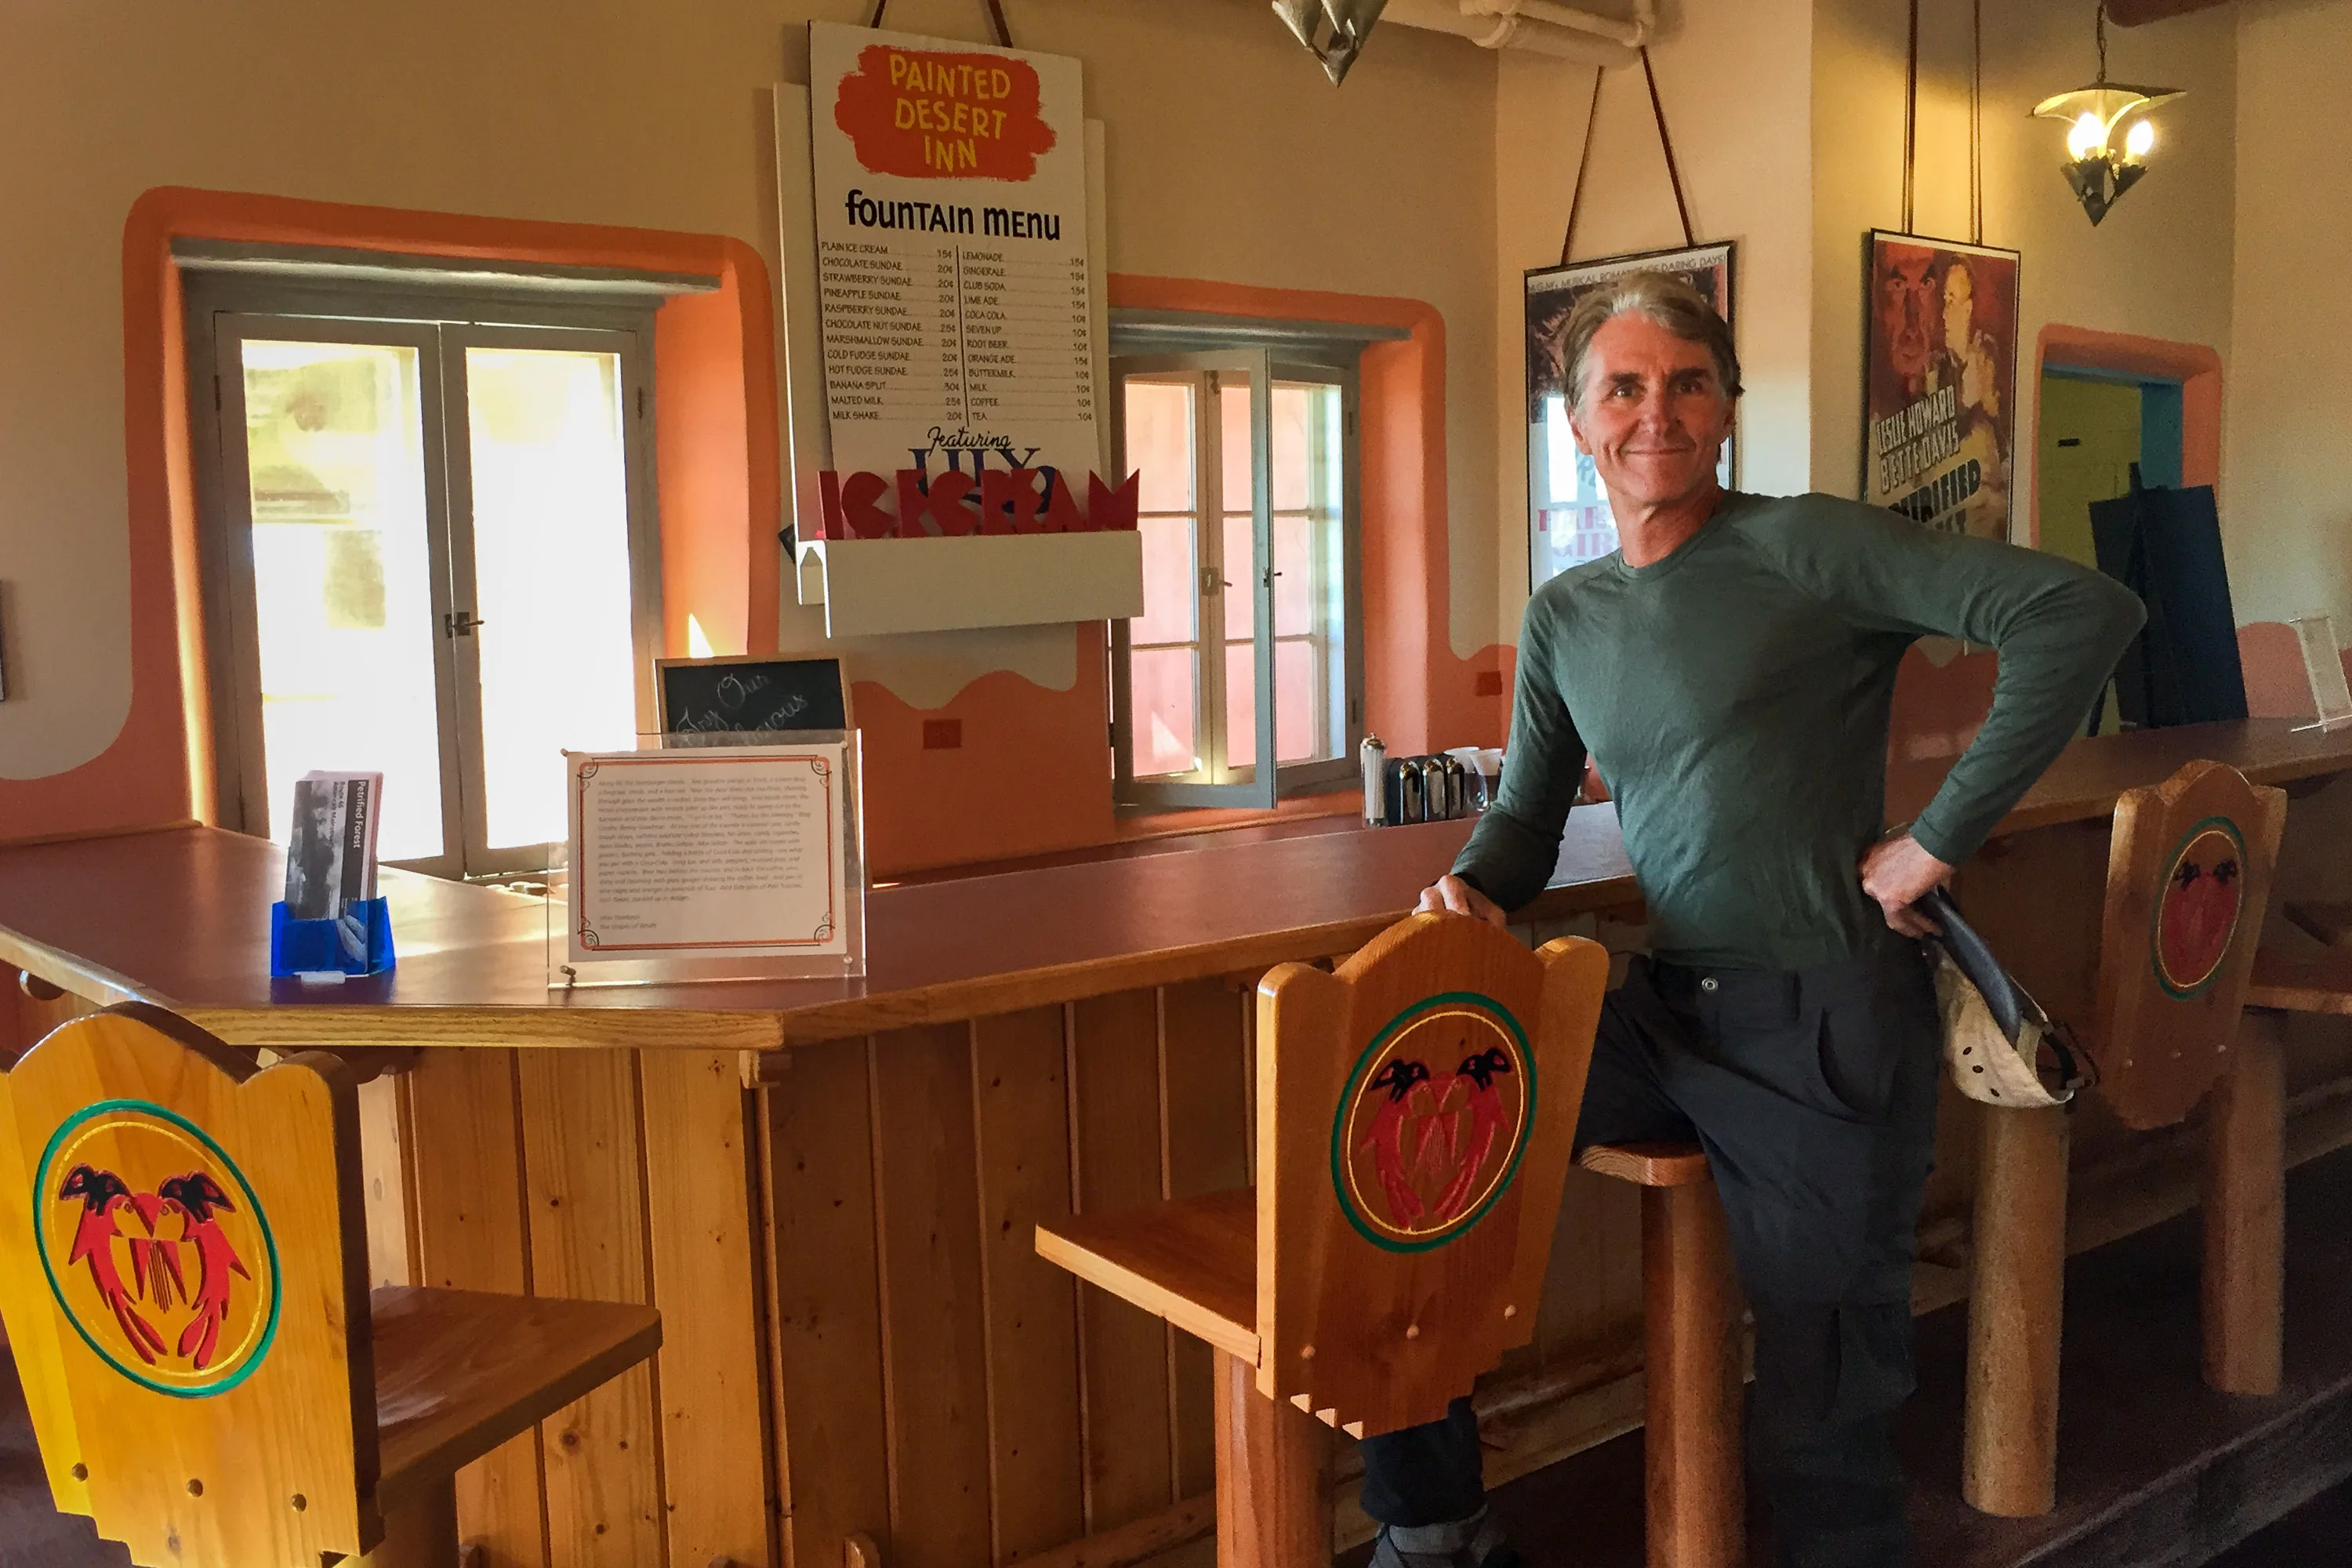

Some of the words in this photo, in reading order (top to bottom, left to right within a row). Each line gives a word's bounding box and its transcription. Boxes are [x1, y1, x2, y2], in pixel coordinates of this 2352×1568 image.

[890, 54, 1011, 100] PAINTED
[895, 97, 1007, 140] DESERT
[924, 135, 977, 172] INN
[822, 241, 844, 252] PLAIN
[845, 244, 858, 252] ICE
[859, 245, 887, 254] CREAM
[962, 252, 1004, 263] LEMONADE
[822, 258, 868, 268] CHOCOLATE
[869, 260, 902, 270] SUNDAE
[937, 265, 953, 274] 20¢
[823, 274, 878, 284] STRAWBERRY
[880, 277, 912, 286] SUNDAE
[938, 279, 954, 289] 20¢
[964, 281, 982, 290] CLUB
[984, 282, 1007, 292] SODA
[824, 288, 867, 299] PINEAPPLE
[869, 290, 901, 301] SUNDAE
[939, 295, 955, 303] 20¢
[964, 296, 982, 305] LIME
[983, 297, 999, 306] ADE
[825, 303, 873, 314] RASPBERRY
[875, 306, 907, 316] SUNDAE
[940, 309, 956, 318] 20¢
[965, 310, 985, 320] COCA
[987, 311, 1007, 321] COLA
[826, 319, 871, 329] CHOCOLATE
[873, 321, 888, 330] NUT
[891, 321, 922, 332] SUNDAE
[966, 325, 991, 335] SEVEN
[992, 326, 1003, 335] UP
[826, 335, 889, 346] MARSHMALLOW
[891, 337, 924, 347] SUNDAE
[941, 339, 957, 347] 20¢
[967, 339, 986, 349] ROOT
[988, 340, 1008, 350] BEER
[828, 350, 848, 359] COLD
[850, 350, 877, 361] FUDGE
[879, 351, 910, 361] SUNDAE
[942, 354, 958, 362] 20¢
[968, 354, 1000, 363] ORANGE
[1000, 355, 1016, 364] ADE
[829, 365, 844, 375] HOT
[846, 366, 873, 376] FUDGE
[874, 367, 908, 376] SUNDAE
[969, 369, 1016, 378] BUTTERMILK
[829, 380, 864, 390] BANANA
[865, 381, 886, 390] SPLIT
[970, 383, 989, 392] MILK
[831, 395, 862, 405] MALTED
[864, 396, 884, 406] MILK
[971, 398, 1000, 407] COFFEE
[833, 411, 852, 420] MILK
[853, 412, 880, 420] SHAKE
[972, 412, 988, 421] TEA
[1876, 409, 1907, 456] LESLIE
[1907, 384, 1955, 440] HOWARD
[927, 426, 1011, 458] Featuring
[1881, 441, 1921, 495] BETTE
[1921, 419, 1959, 471] DAVIS
[1888, 458, 1981, 523] TRIFIED
[355, 781, 366, 819] Petrified
[353, 820, 364, 848] Forest
